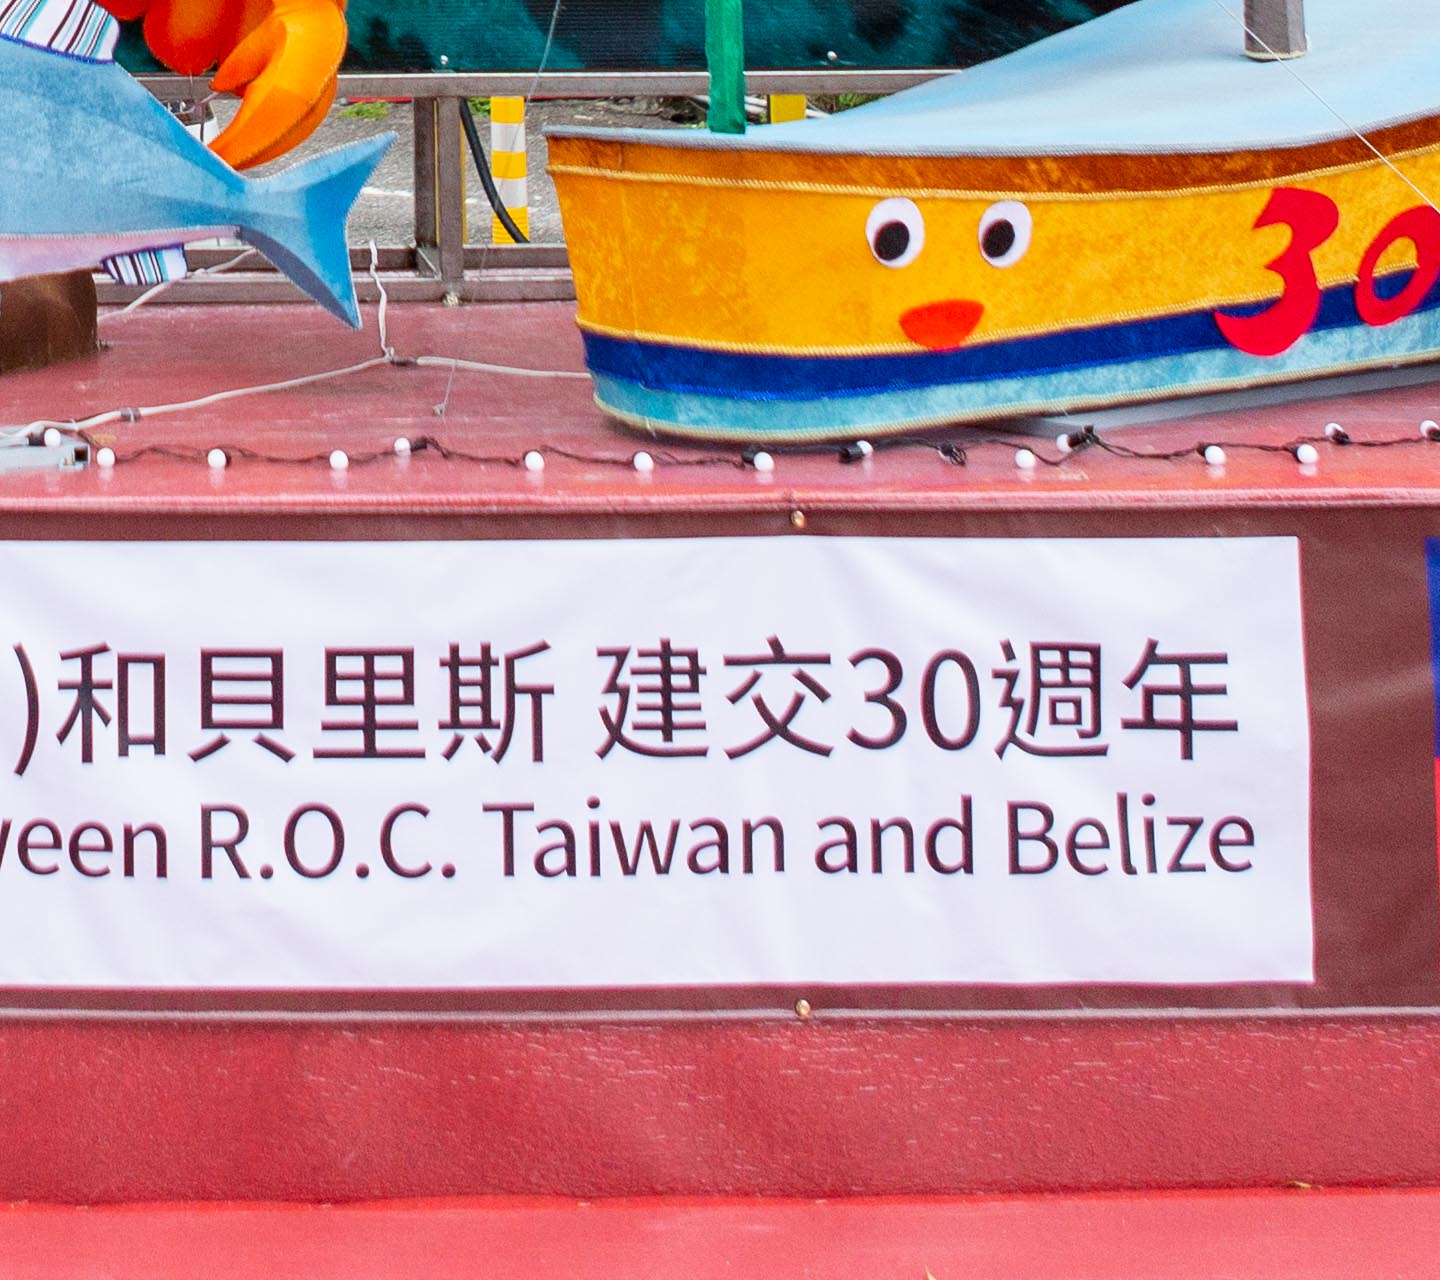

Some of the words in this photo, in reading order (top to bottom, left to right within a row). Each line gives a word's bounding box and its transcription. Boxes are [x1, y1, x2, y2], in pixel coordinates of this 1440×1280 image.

[594, 635, 1239, 761] 建交30週年
[199, 800, 456, 880] R.O.C.
[481, 796, 785, 878] Taiwan
[813, 794, 974, 877] and
[1006, 791, 1255, 877] Belize
